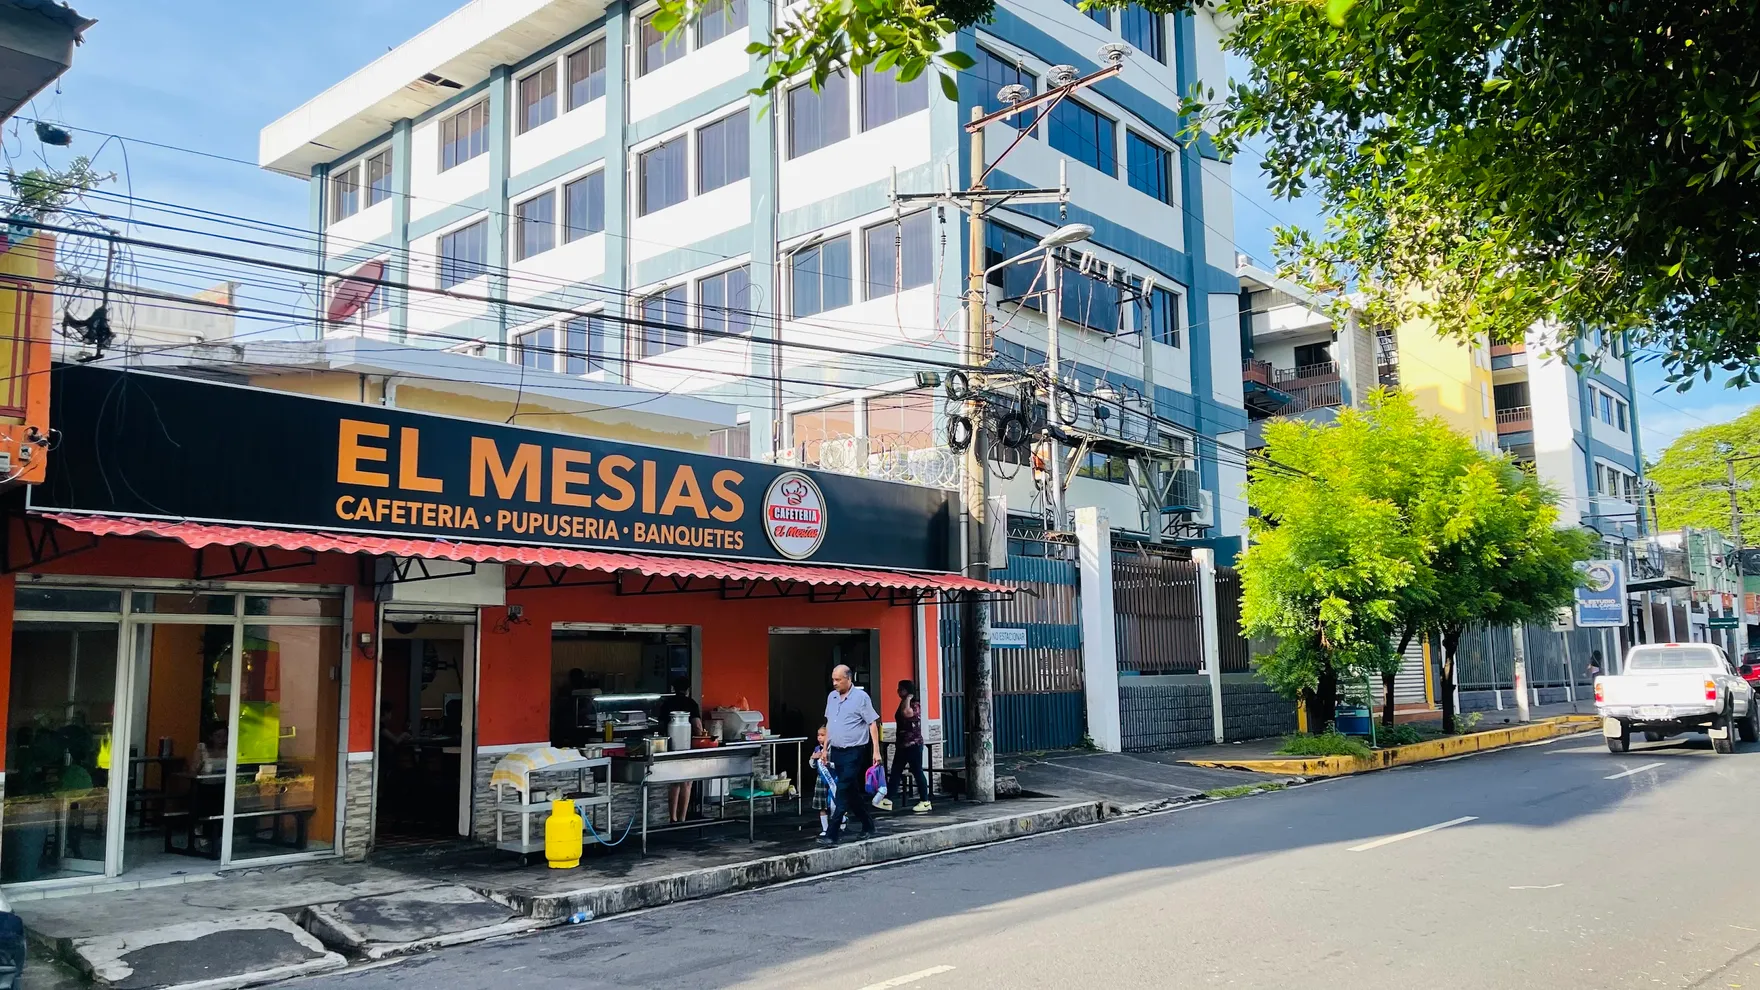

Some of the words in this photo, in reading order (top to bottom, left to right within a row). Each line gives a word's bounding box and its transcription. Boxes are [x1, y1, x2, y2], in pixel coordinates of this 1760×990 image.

[337, 418, 443, 493] EL
[469, 436, 745, 523] MESIAS
[775, 507, 817, 521] CAFETERIA
[335, 494, 479, 530] CAFETERIA
[497, 509, 620, 541] PUPUSERIA
[634, 522, 744, 551] BANQUETES
[774, 525, 786, 537] El
[992, 632, 999, 641] NO
[999, 632, 1025, 641] ESTACIONAR
